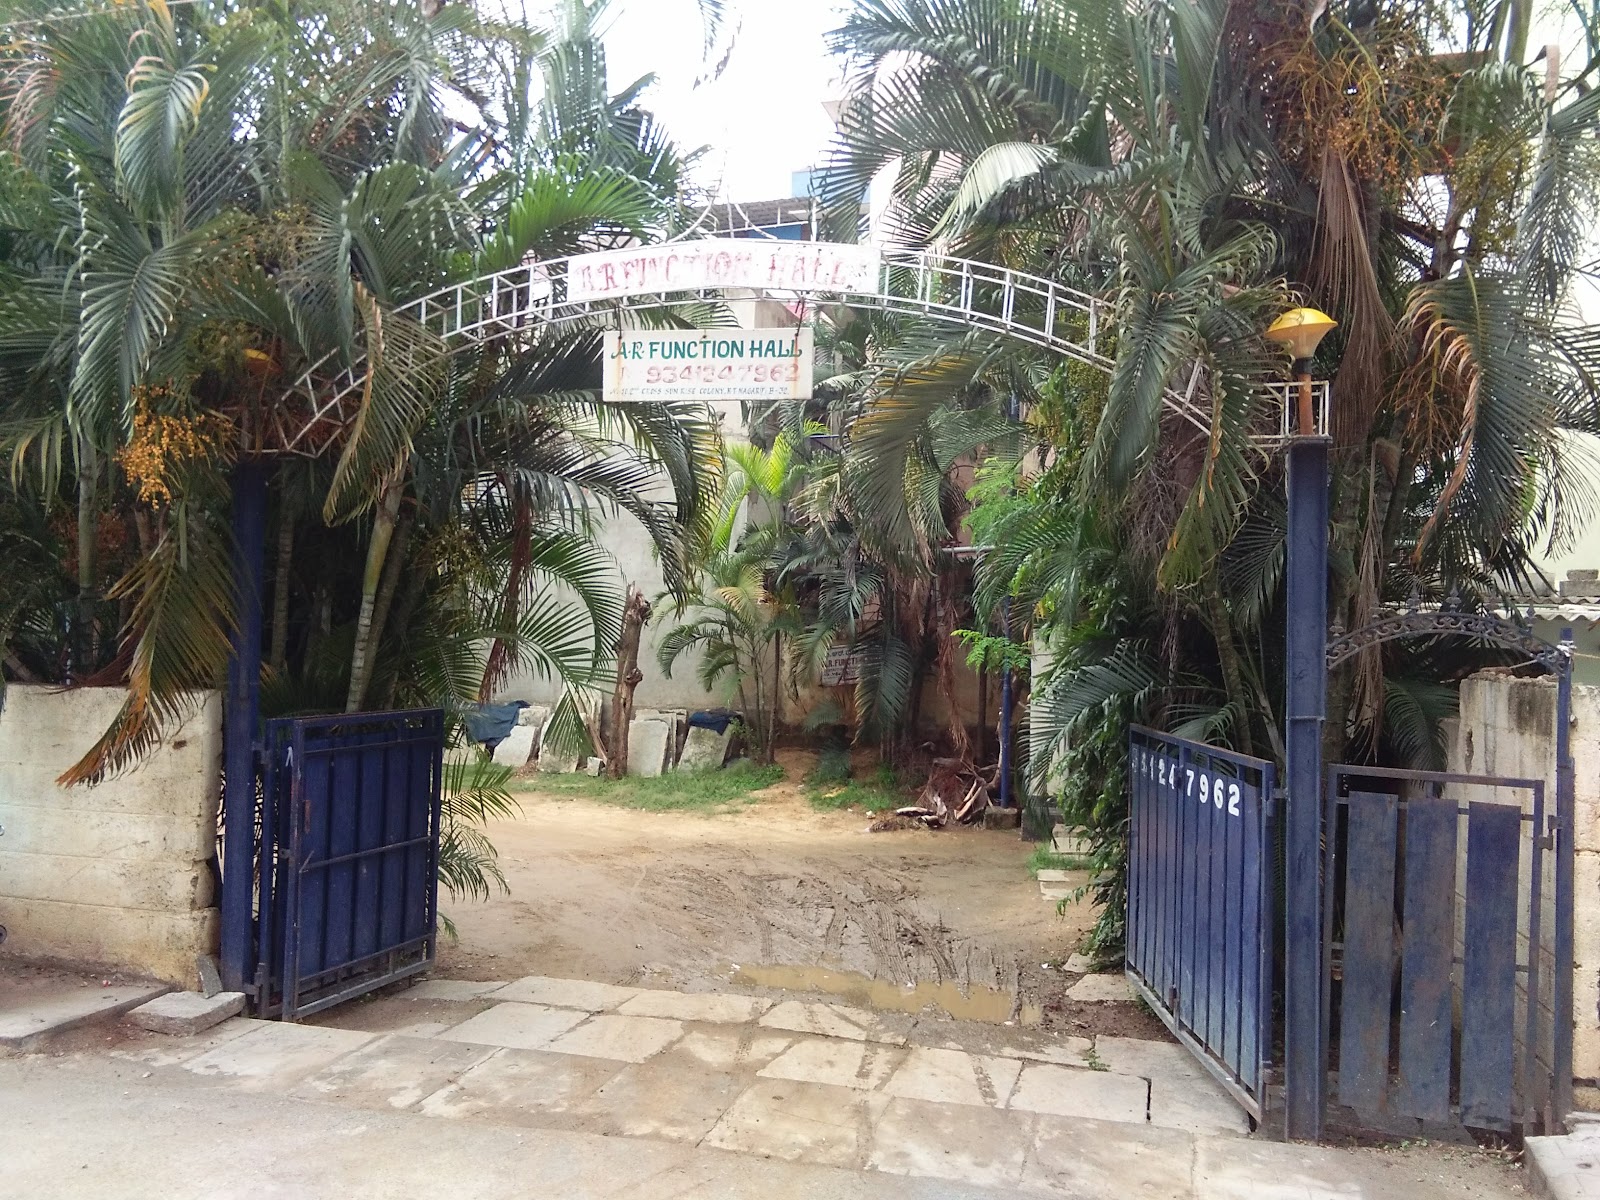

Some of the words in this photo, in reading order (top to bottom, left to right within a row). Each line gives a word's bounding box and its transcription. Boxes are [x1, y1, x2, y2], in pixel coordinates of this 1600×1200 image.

[648, 339, 745, 360] FUNCTION
[749, 339, 803, 359] HALL
[646, 363, 801, 384] 9341247962
